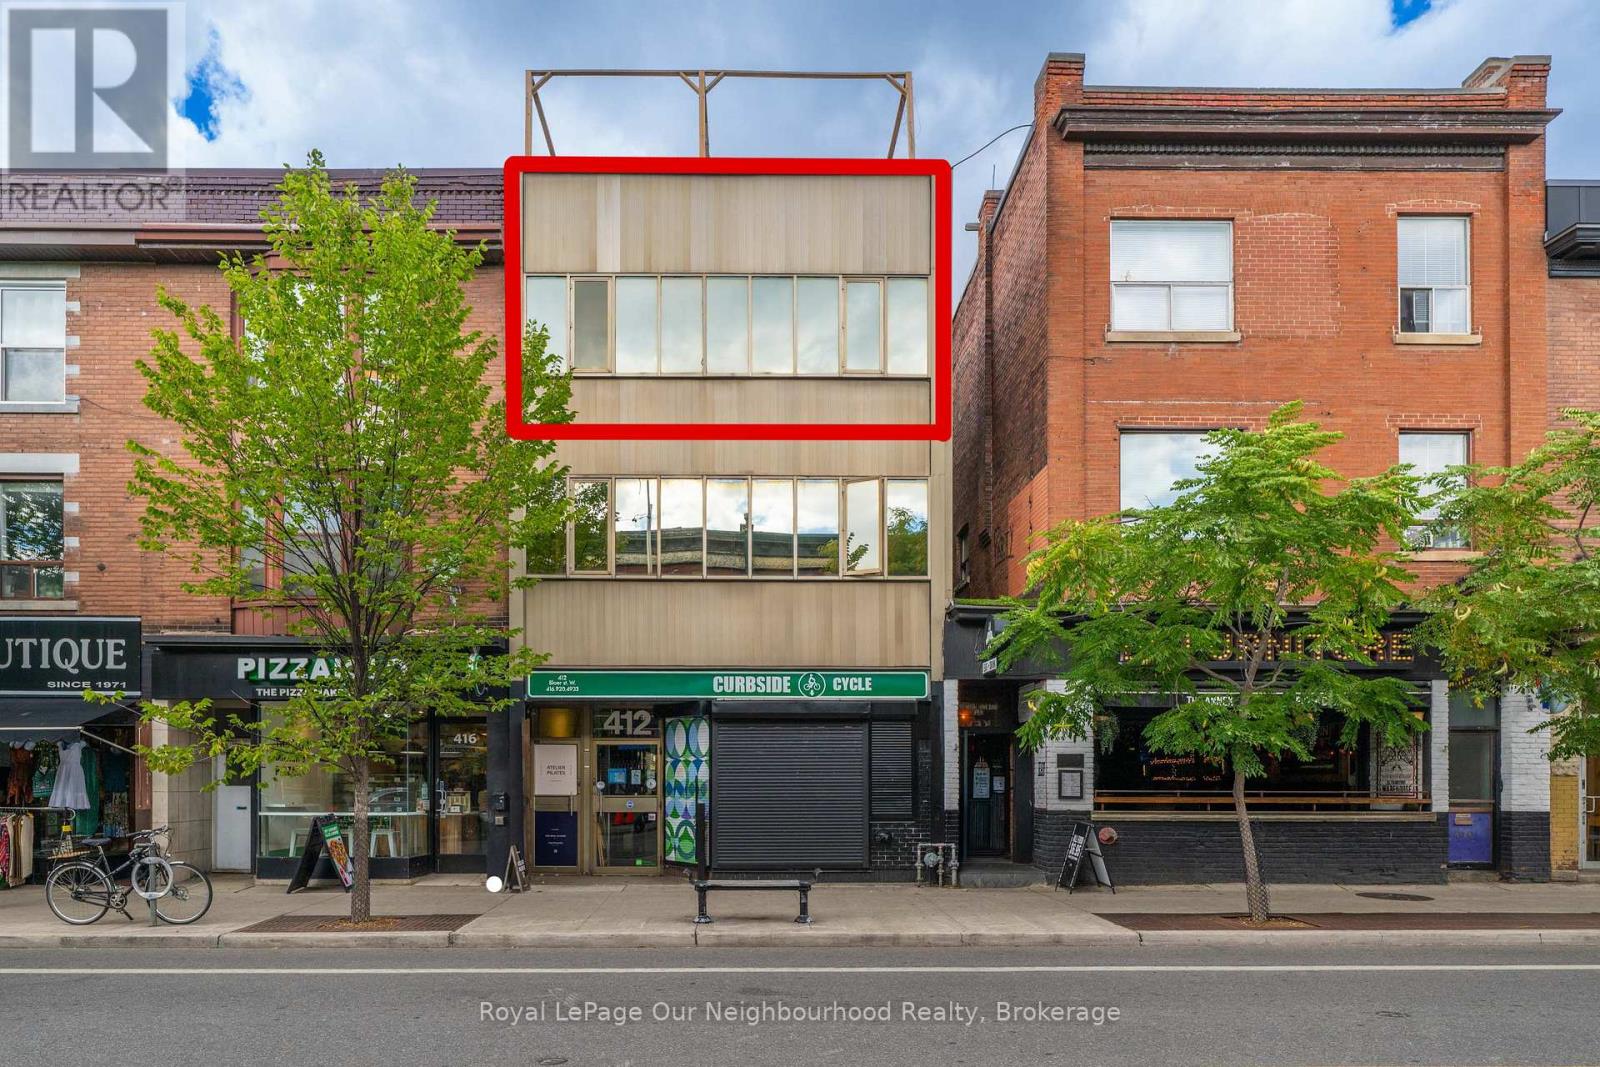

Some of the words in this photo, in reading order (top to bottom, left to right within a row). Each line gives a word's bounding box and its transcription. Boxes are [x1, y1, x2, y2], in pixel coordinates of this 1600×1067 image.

[712, 676, 791, 693] CURBSIDE
[832, 677, 872, 691] CYCLE
[256, 688, 277, 696] THE
[279, 688, 306, 696] PIZZ
[603, 710, 651, 735] 412
[453, 733, 477, 744] 416
